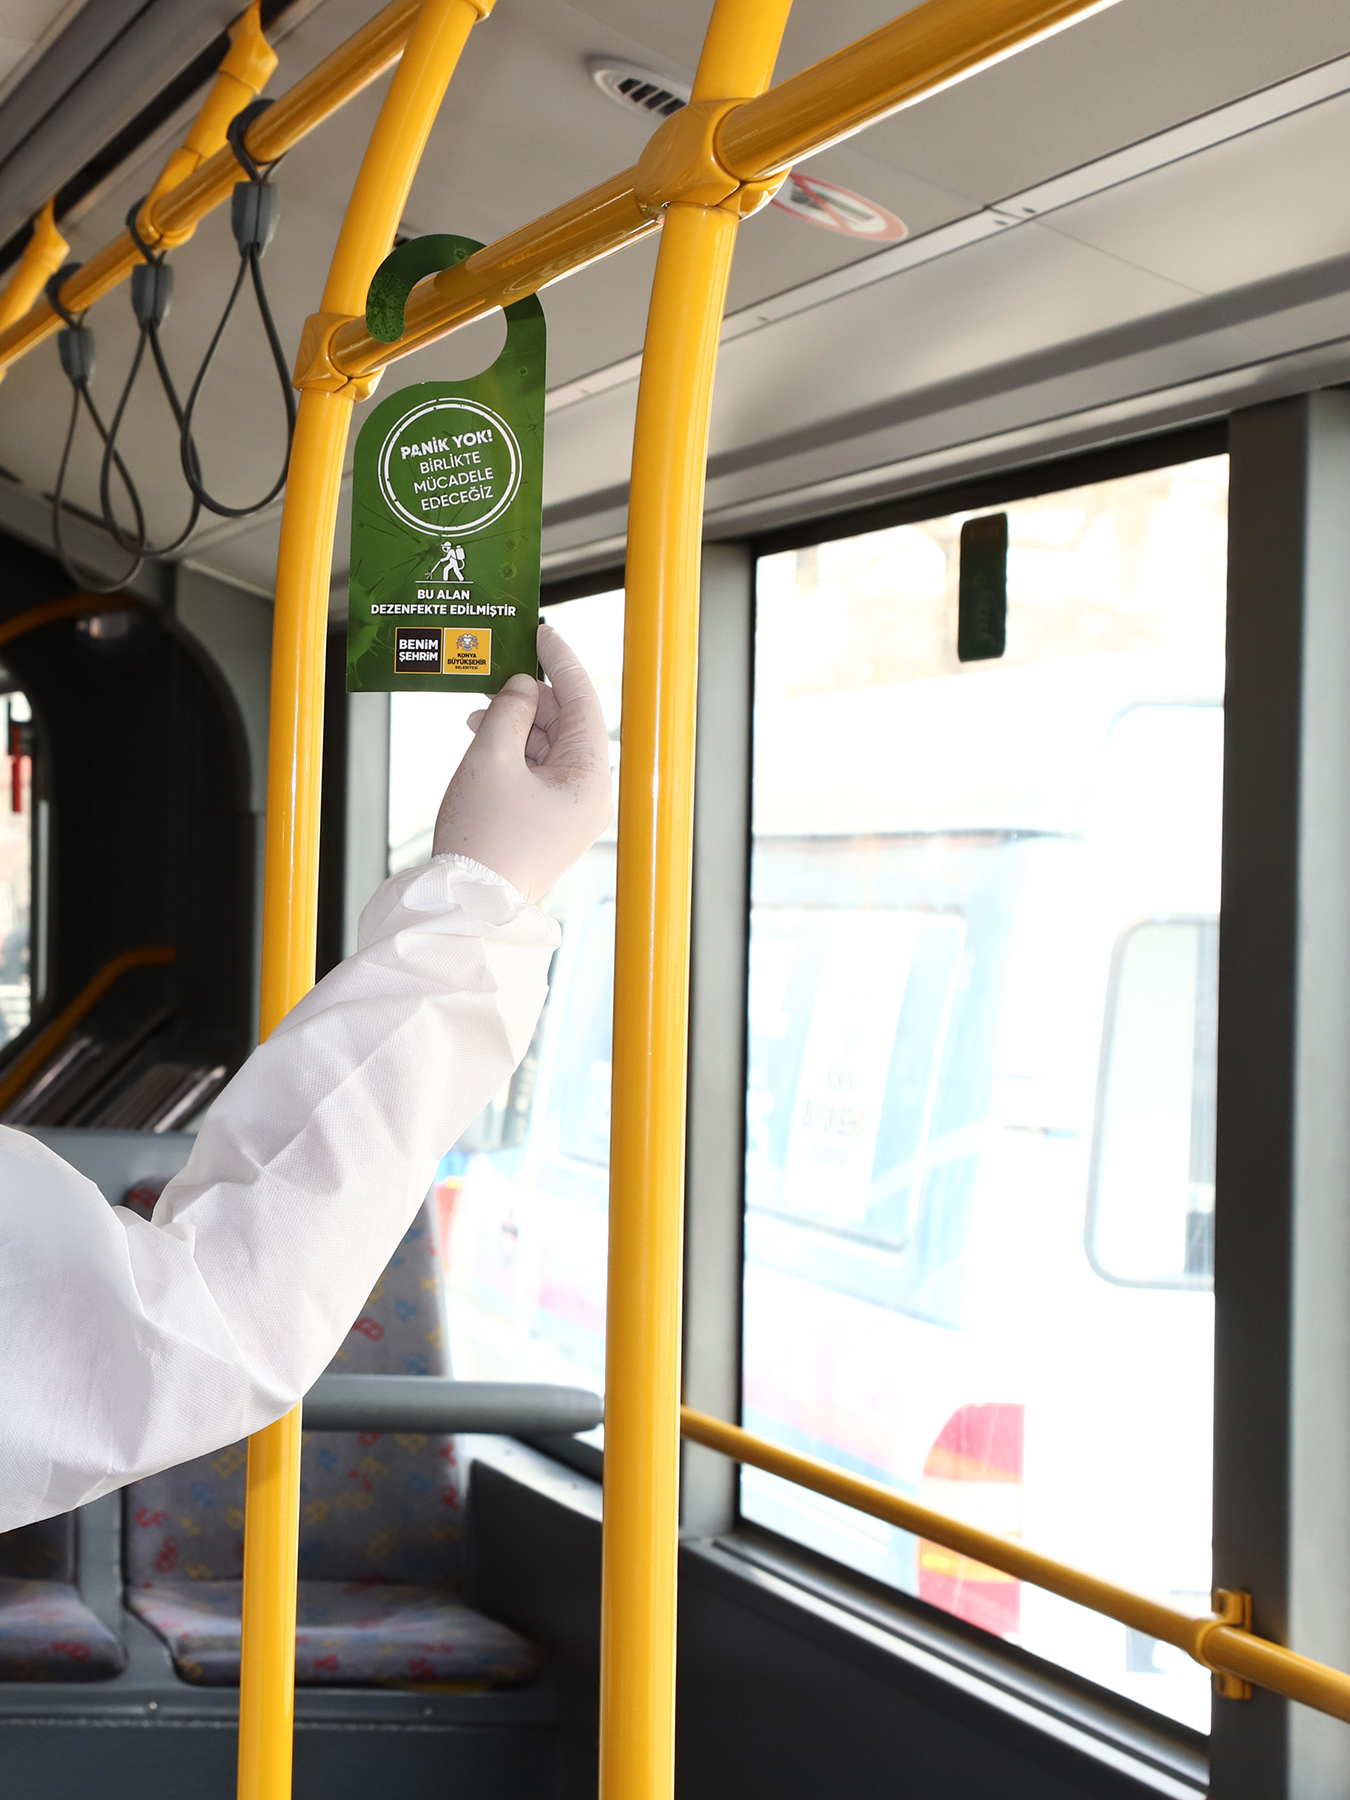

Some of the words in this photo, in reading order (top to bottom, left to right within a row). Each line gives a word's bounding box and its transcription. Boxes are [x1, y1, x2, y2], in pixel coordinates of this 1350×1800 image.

[400, 436, 450, 460] PANİK
[451, 429, 494, 449] YOK!
[419, 450, 482, 475] BİRLİKTE
[413, 467, 495, 494] MÜCADELE
[420, 484, 494, 511] EDECEĞİZ
[417, 589, 434, 600] BU
[436, 589, 470, 600] ALAN
[370, 604, 448, 615] DEZENFEKTE
[449, 602, 517, 617] EDİLMİŞTİR
